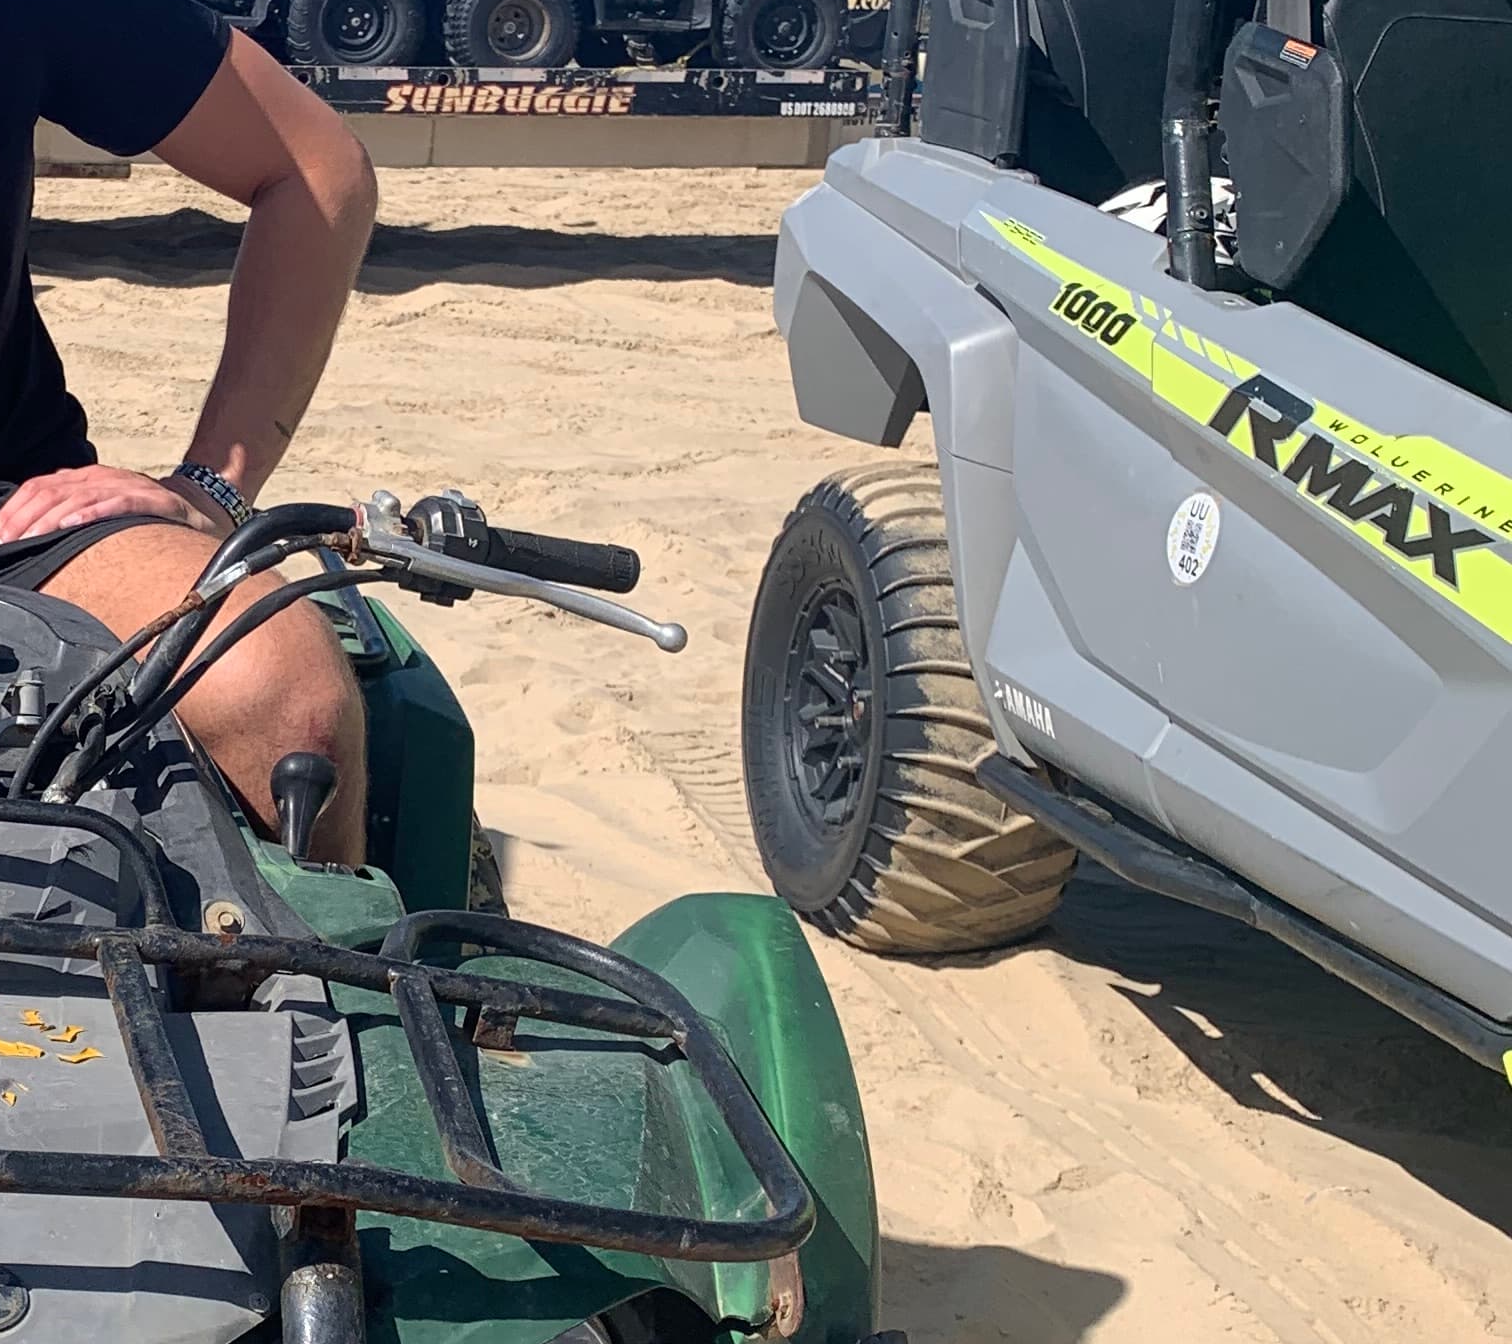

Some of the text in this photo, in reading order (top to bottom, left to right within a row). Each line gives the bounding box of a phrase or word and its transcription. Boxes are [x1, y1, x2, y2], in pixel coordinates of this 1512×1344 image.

[384, 84, 635, 113] SUNBUGGIE
[1052, 282, 1137, 346] 1000
[1207, 374, 1497, 589] RMAX
[1190, 499, 1211, 521] UU
[1178, 554, 1200, 577] 402
